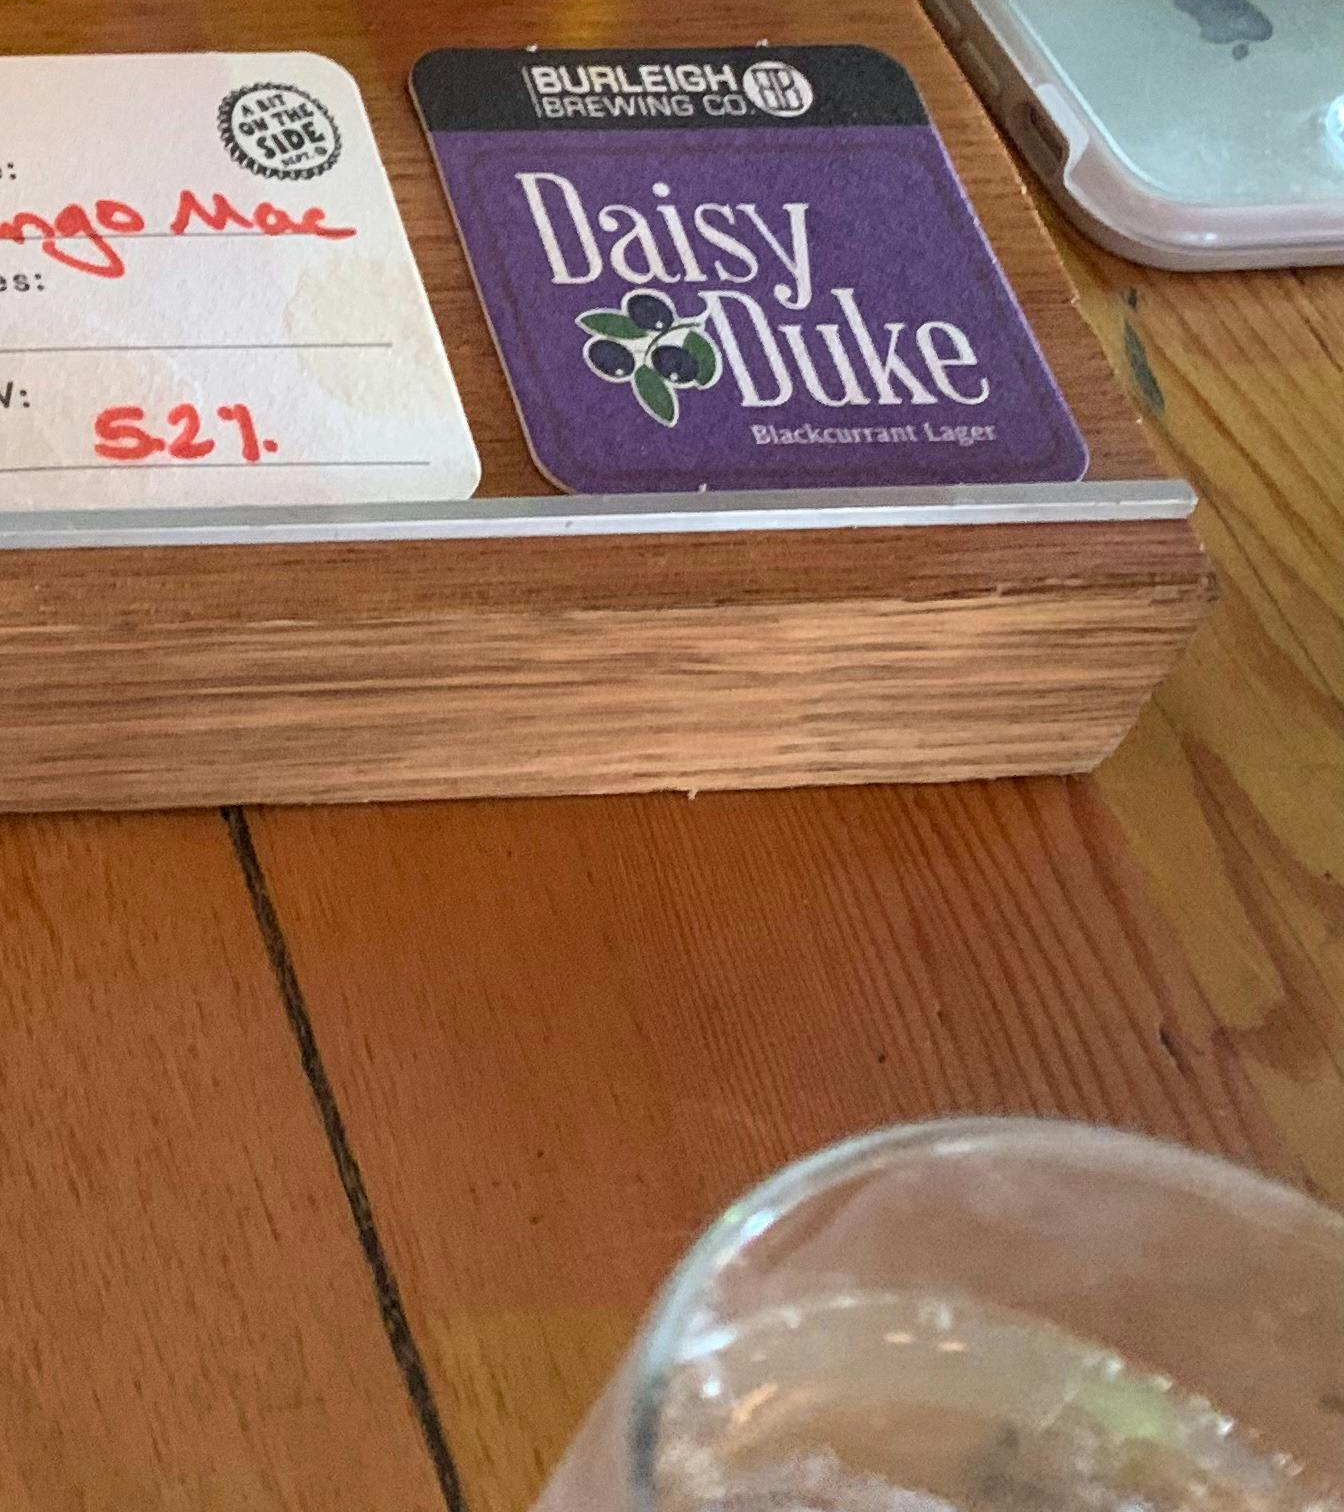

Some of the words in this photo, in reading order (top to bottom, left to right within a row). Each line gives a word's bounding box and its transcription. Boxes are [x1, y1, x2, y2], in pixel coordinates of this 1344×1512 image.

[529, 63, 737, 95] BURLEIGH
[541, 94, 694, 118] BREWING
[702, 93, 757, 117] CO.
[256, 121, 326, 160] SIDE
[170, 189, 357, 238] Mac
[514, 172, 811, 310] Daisy
[697, 287, 991, 409] Duke
[752, 423, 917, 446] Blackcurrant
[924, 424, 997, 448] Lager
